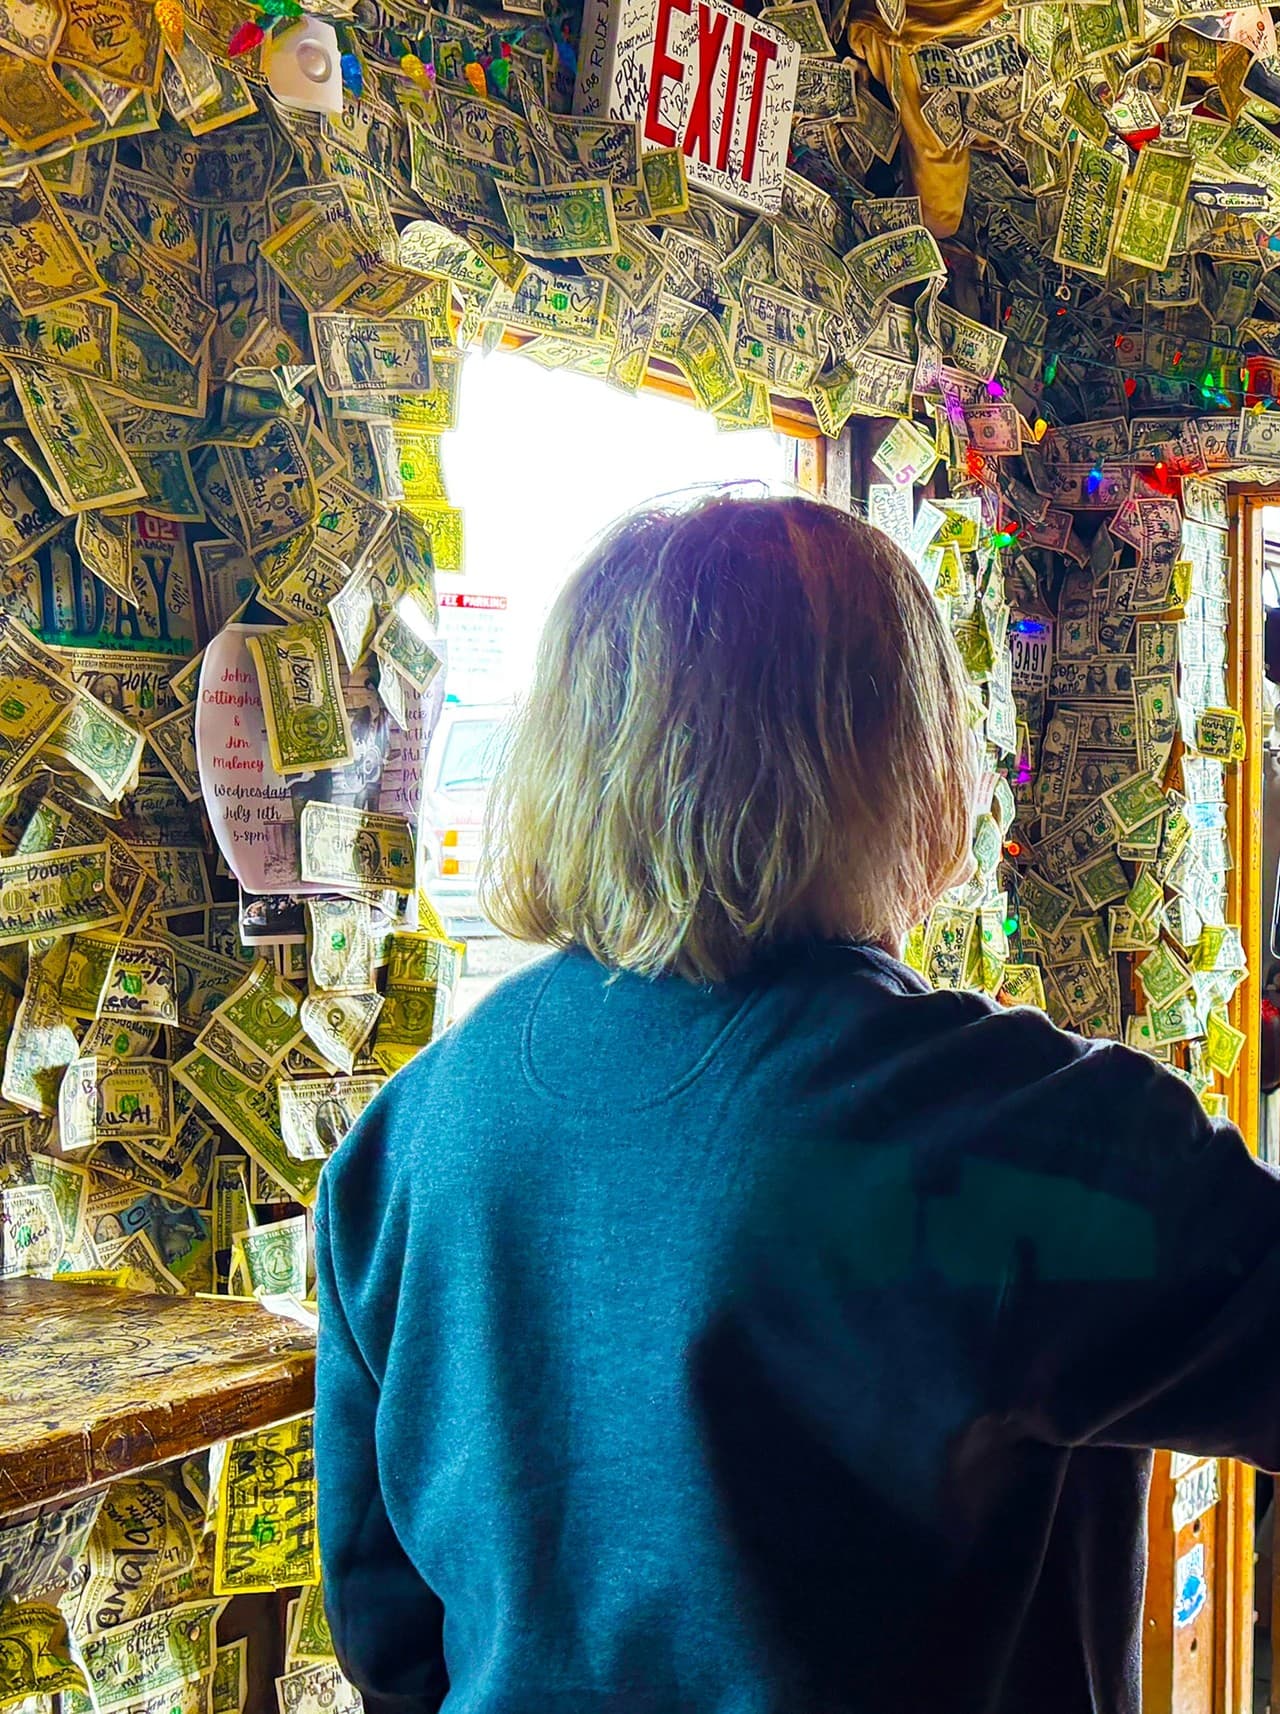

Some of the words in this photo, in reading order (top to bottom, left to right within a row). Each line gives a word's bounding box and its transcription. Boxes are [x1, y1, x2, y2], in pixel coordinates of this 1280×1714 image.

[920, 46, 954, 65] THE
[926, 69, 941, 84] IS
[944, 61, 998, 84] EATING
[644, 0, 779, 183] EXIT
[221, 668, 254, 684] John
[202, 690, 263, 708] Cottingha
[233, 714, 241, 727] &
[224, 735, 252, 750] Jim
[212, 756, 265, 773] Maloney
[214, 783, 290, 800] Wednesday
[222, 806, 251, 823] July
